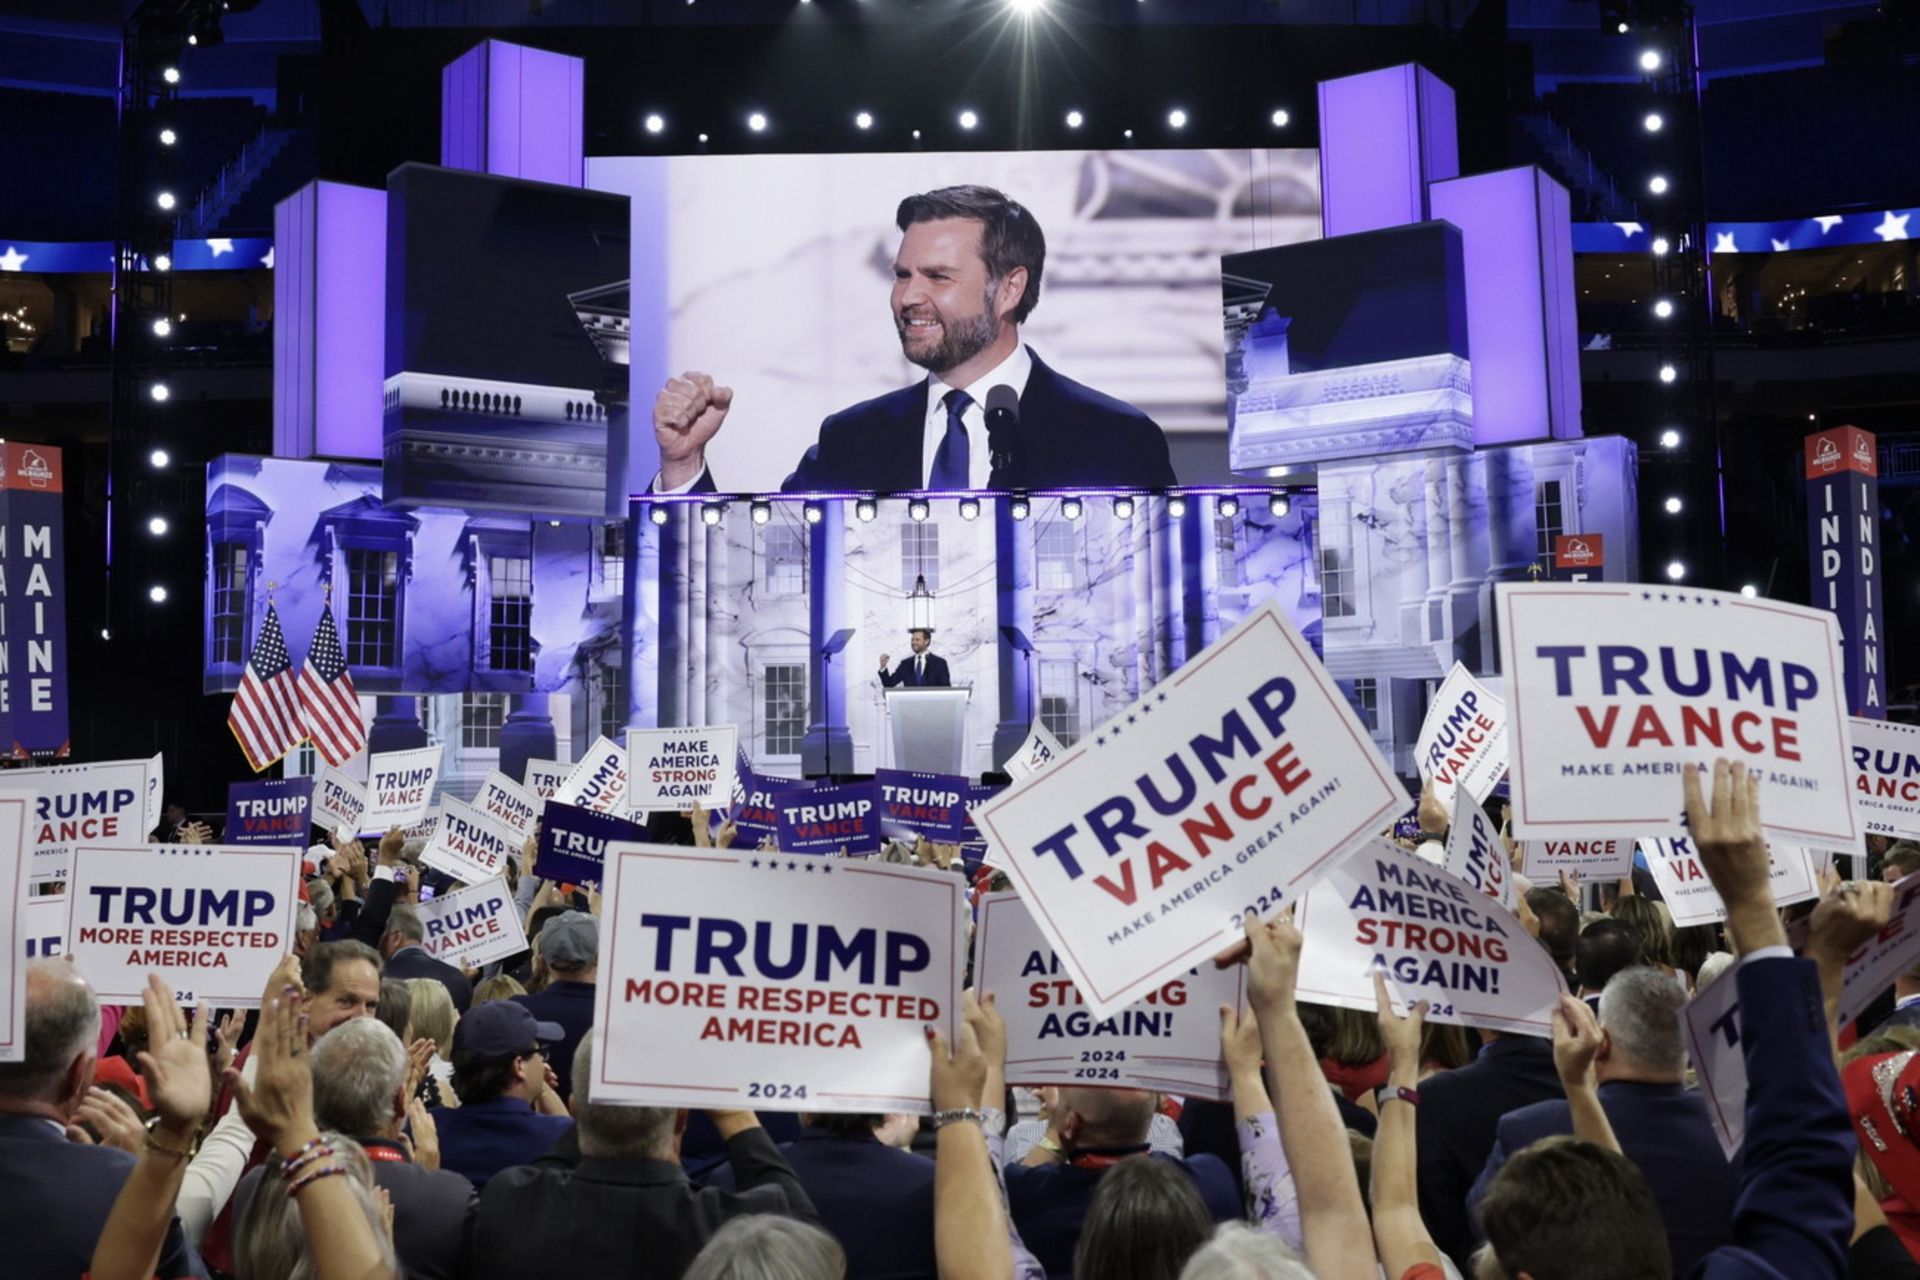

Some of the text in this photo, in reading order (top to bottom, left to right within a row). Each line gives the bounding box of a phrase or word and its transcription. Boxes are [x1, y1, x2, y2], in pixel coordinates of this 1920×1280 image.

[1860, 483, 1879, 707] INDIANA
[24, 525, 52, 711] MAINE
[1536, 645, 1818, 712] TRUMP
[663, 741, 708, 754] MAKE
[1425, 690, 1478, 776] TRUMP
[1575, 705, 1801, 761] VANCE
[649, 755, 719, 769] AMERICA
[1435, 714, 1495, 785] VANCE
[375, 767, 433, 790] TRUMP
[574, 754, 620, 807] RUMP
[652, 769, 716, 783] STRONG
[657, 784, 712, 797] AGAIN!
[1032, 676, 1296, 880] TRUMP
[1561, 763, 1614, 776] MAKE
[1622, 761, 1708, 775] AMERIA
[1769, 771, 1819, 791] AGAIN!
[37, 789, 135, 820] RUMP
[236, 796, 308, 818] TRUMP
[324, 796, 357, 824] VANCE
[325, 780, 364, 814] TRUMP
[379, 788, 424, 806] VANCE
[487, 784, 534, 818] TRUMP
[881, 785, 960, 808] TRUMP
[1887, 804, 1914, 813] GREAT
[244, 815, 304, 832] VANCE
[486, 799, 527, 830] VANCE
[783, 800, 872, 824] TRUMP
[889, 803, 951, 822] VANCE
[1093, 742, 1312, 907] VANCE
[37, 817, 118, 844] ANCE
[446, 813, 505, 854] TRUMP
[551, 828, 604, 855] TRU
[795, 819, 864, 837] VANCE
[1867, 822, 1895, 832] 2024
[34, 848, 68, 856] AMERICA
[447, 833, 497, 868] VANCE
[1107, 777, 1342, 945] MAKE AMERICA GREAT AGAIN!
[1544, 840, 1617, 855] VANCE
[1375, 859, 1470, 904] MAKE
[90, 886, 275, 927] TRUMP
[426, 898, 503, 937] RUMP
[1349, 884, 1509, 938] AMERICA
[79, 928, 279, 948] MORE RESPECTED
[424, 918, 500, 955] VANCE
[640, 913, 931, 986] TRUMP
[1355, 917, 1509, 963] STRONG
[126, 950, 228, 967] AMERICA
[466, 960, 481, 968] 024
[1363, 953, 1500, 995] AGAIN!
[624, 978, 940, 1022] MORE RESPECTED
[1406, 1000, 1454, 1017] 224
[700, 1016, 862, 1049] AMERICA
[1037, 1010, 1173, 1039] AGAIN!
[1081, 1051, 1126, 1062] 2024
[1075, 1068, 1120, 1080] 2024
[747, 1082, 808, 1100] 2024
